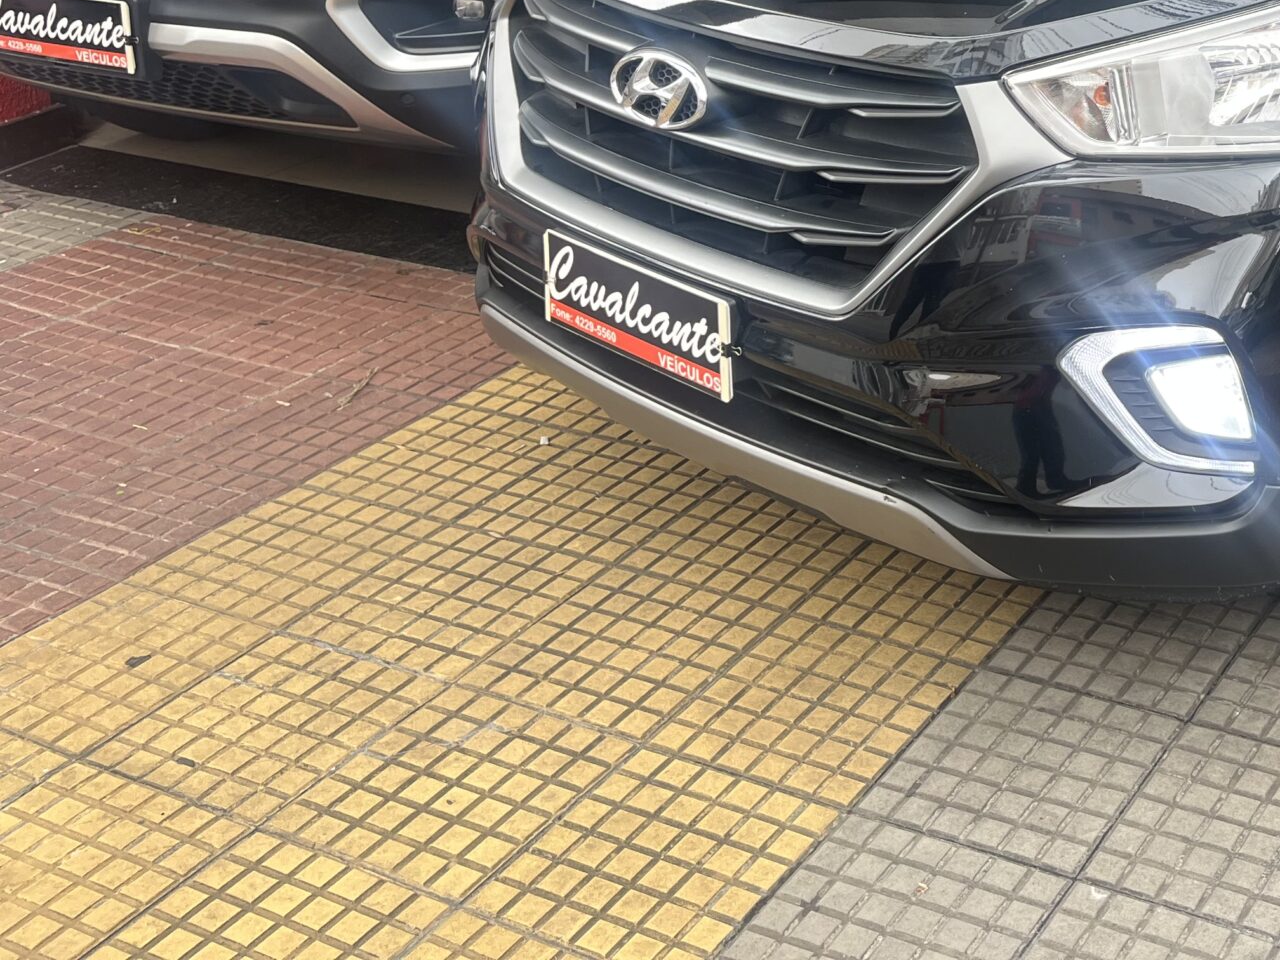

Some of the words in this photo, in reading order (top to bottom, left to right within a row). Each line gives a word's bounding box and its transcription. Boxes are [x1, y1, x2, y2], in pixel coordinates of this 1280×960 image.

[75, 49, 127, 68] VEÍCULOS
[549, 245, 722, 364] Cavalcante
[550, 303, 573, 323] Fone:
[574, 315, 617, 344] 4229-5560
[657, 351, 722, 392] VEÍCULOS
